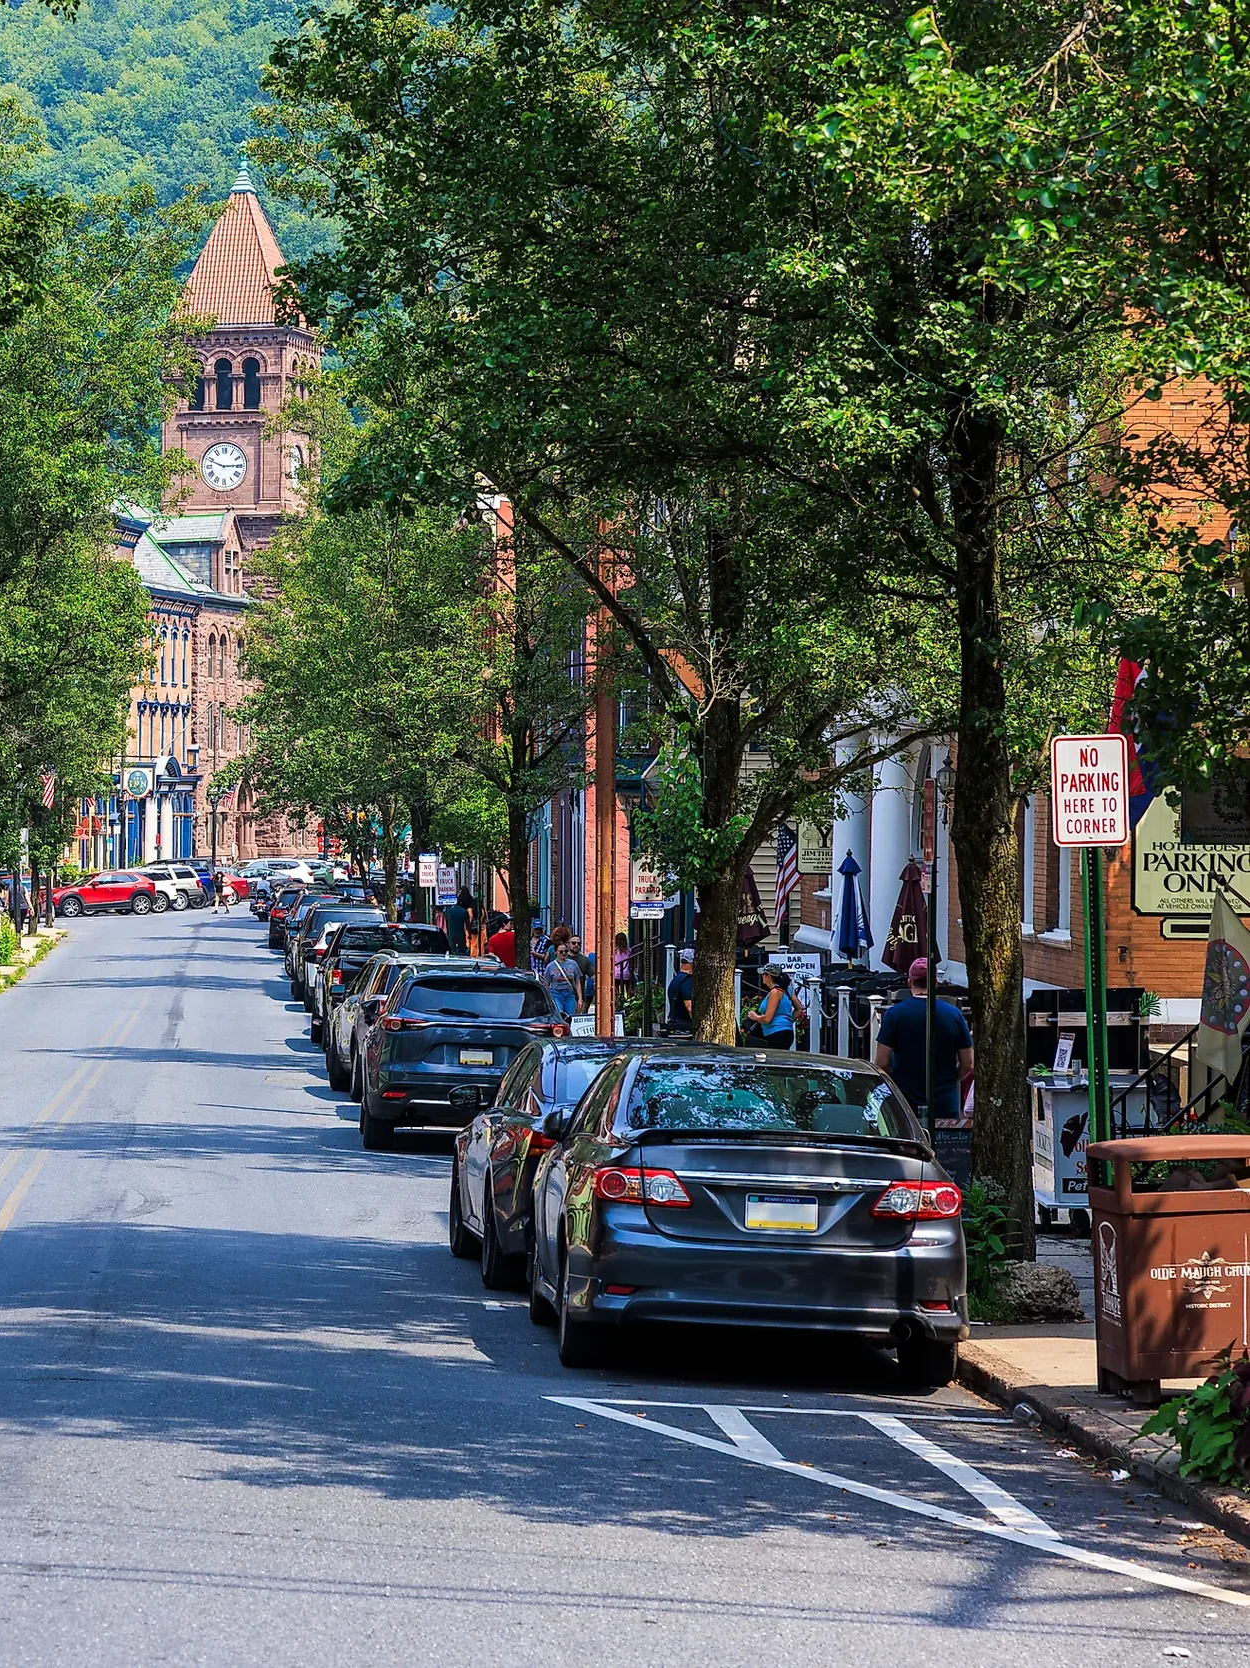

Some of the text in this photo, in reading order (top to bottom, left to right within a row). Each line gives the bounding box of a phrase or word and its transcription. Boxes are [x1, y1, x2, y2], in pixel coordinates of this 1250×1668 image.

[1080, 747, 1098, 767] NO
[1061, 772, 1119, 792] PARKING
[1064, 797, 1117, 813] HERE TO
[1066, 818, 1116, 834] CORNER
[1152, 842, 1199, 851] HOTEL
[638, 875, 657, 883] TRUCK
[1163, 873, 1235, 893] ONLY
[1150, 1268, 1176, 1280] OLDE
[1180, 1266, 1222, 1280] MAUCH
